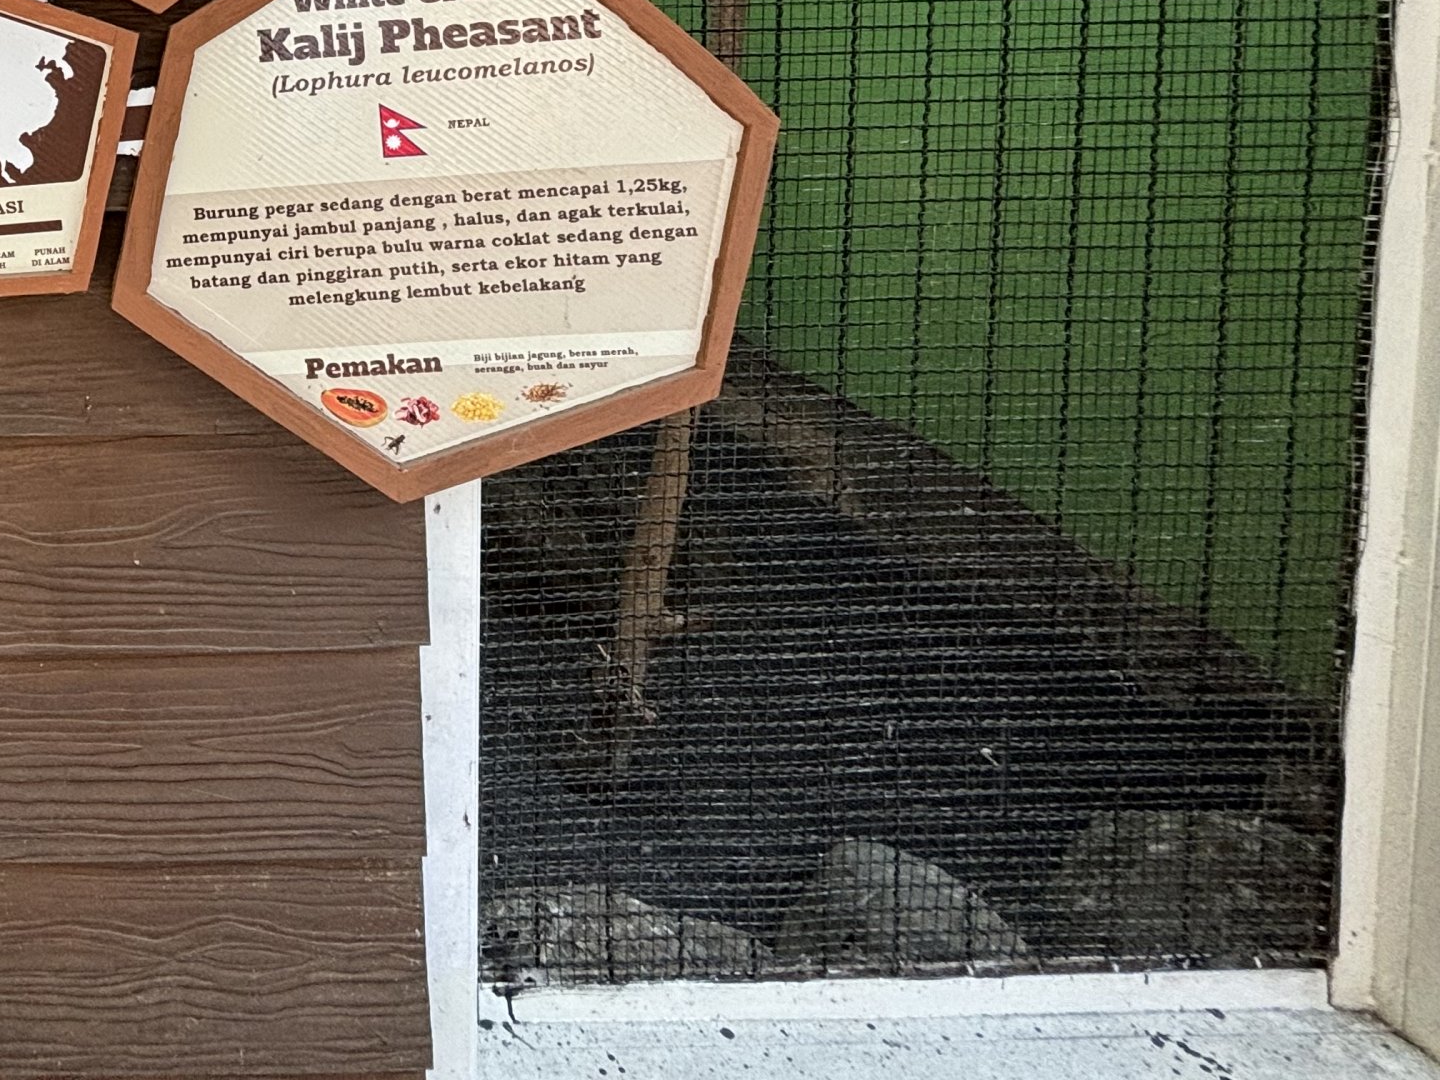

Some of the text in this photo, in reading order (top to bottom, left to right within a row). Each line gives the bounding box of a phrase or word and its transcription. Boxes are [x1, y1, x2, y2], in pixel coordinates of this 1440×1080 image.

[257, 9, 602, 65] Kalij Pheasant
[271, 53, 595, 98] (Lophura leucomelanos)
[448, 118, 490, 129] NEPAL
[193, 178, 688, 220] Burung pegar sedang dengan berat mencapai 1,25kg,
[183, 224, 288, 244] mempunyai
[293, 220, 357, 239] jambul
[363, 216, 436, 235] panjang
[454, 212, 511, 227] halus,
[516, 209, 551, 223] dan
[558, 205, 602, 221] agak
[607, 201, 690, 217] terkulai,
[34, 247, 66, 256] PUNAH
[166, 225, 698, 268] mempunyai ciri berupa bulu warna coklat sedang dengan
[44, 257, 71, 266] ALAM
[190, 251, 662, 289] batang dan pinggiran putih, serta ekor hitam yang
[288, 278, 586, 306] melengkung lembut kebelakang
[304, 354, 443, 379] Pemakan
[527, 349, 566, 362] jagung,
[568, 348, 598, 359] beras
[600, 347, 639, 358] merah,
[527, 361, 555, 371] buah
[558, 360, 577, 370] dan
[579, 360, 609, 371] sayur
